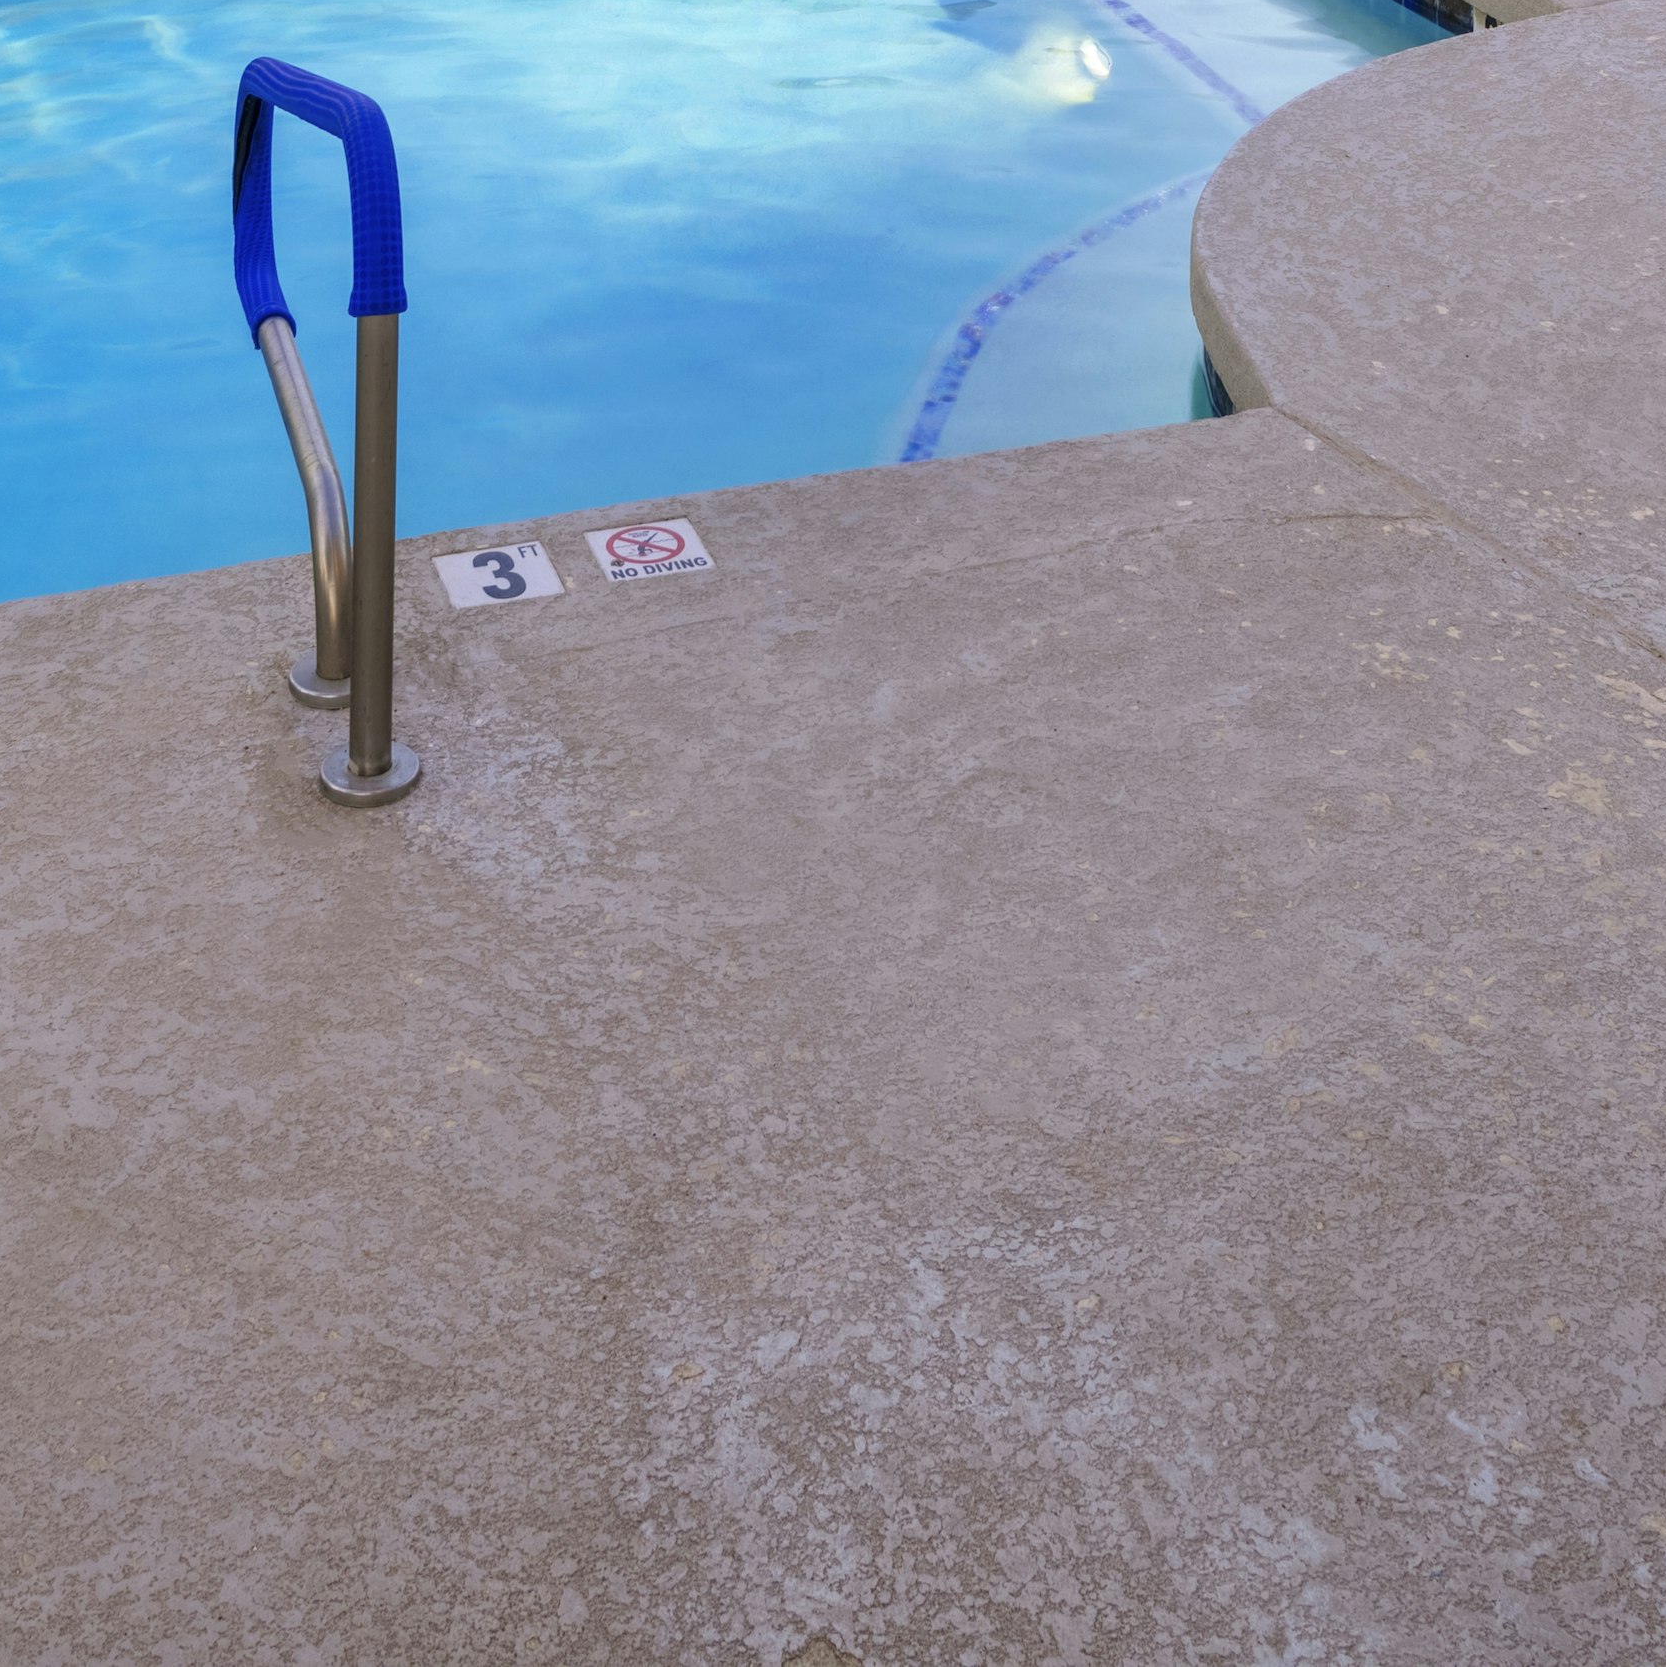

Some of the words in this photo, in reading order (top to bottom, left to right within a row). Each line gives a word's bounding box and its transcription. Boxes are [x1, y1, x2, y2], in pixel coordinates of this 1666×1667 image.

[472, 550, 527, 600] 3
[516, 543, 539, 559] FT
[610, 567, 639, 580] NO
[643, 556, 708, 575] DIVING
